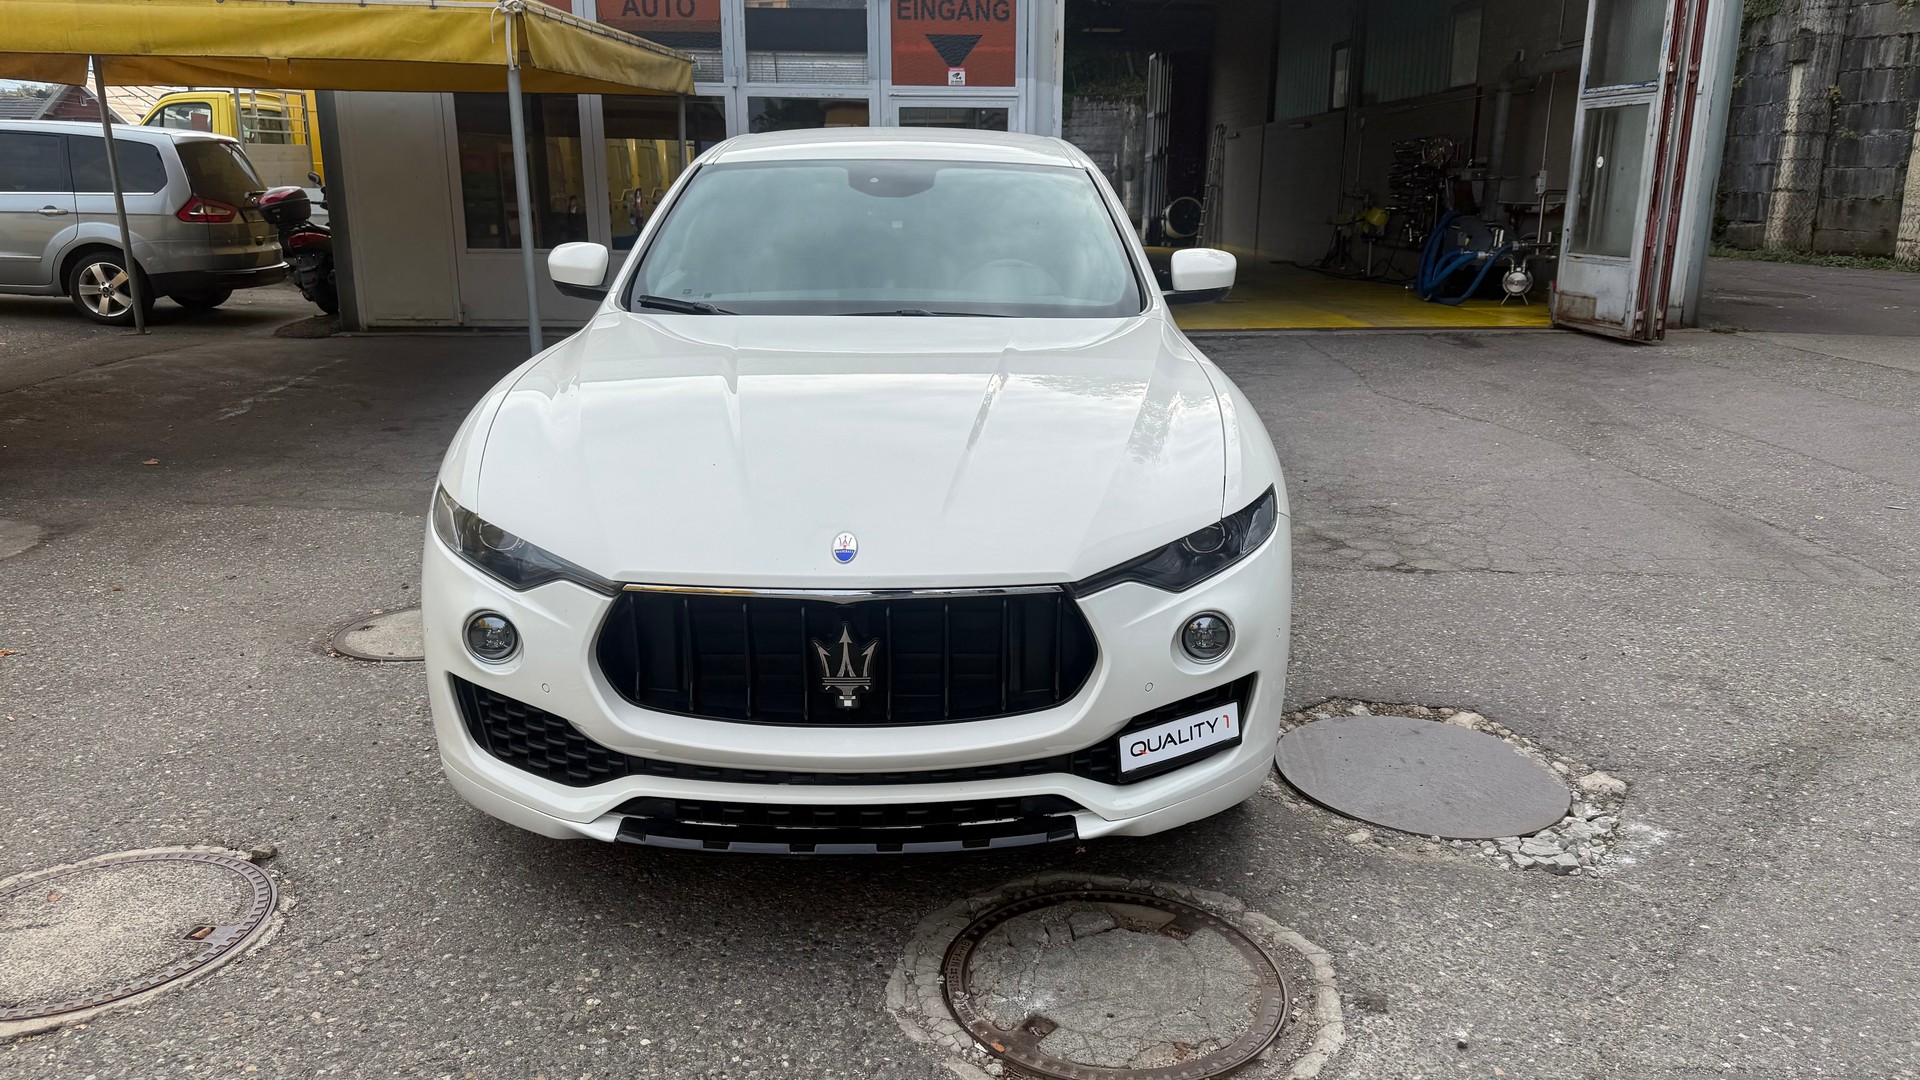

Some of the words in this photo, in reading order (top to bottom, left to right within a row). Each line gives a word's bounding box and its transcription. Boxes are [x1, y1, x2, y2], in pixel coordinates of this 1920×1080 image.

[622, 0, 696, 18] AUTO
[897, 0, 1010, 22] EINGANG
[1130, 717, 1219, 757] QUALITY
[1223, 714, 1231, 729] 1
